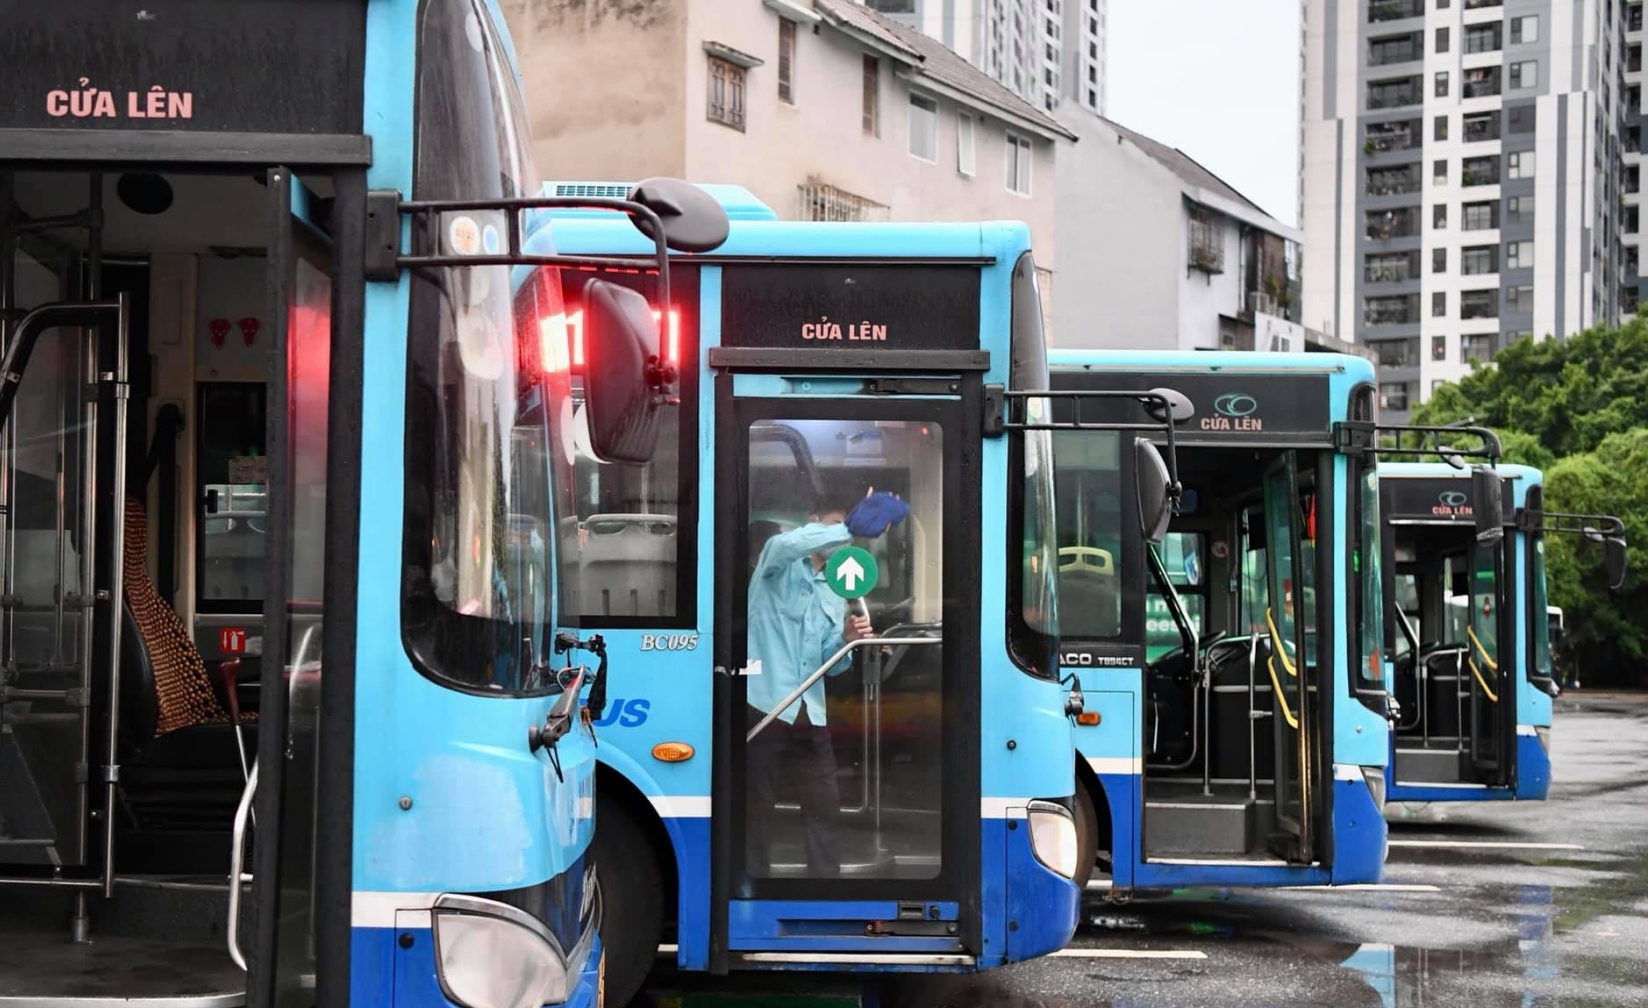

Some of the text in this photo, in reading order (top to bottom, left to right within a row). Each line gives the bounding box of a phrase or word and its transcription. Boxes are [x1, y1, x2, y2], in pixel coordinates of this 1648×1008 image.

[46, 77, 192, 118] CỬA LÊN
[802, 316, 887, 340] CỬA LÊN
[1201, 413, 1262, 430] CỬA LÊN
[641, 634, 698, 650] BC095
[579, 698, 651, 728] US
